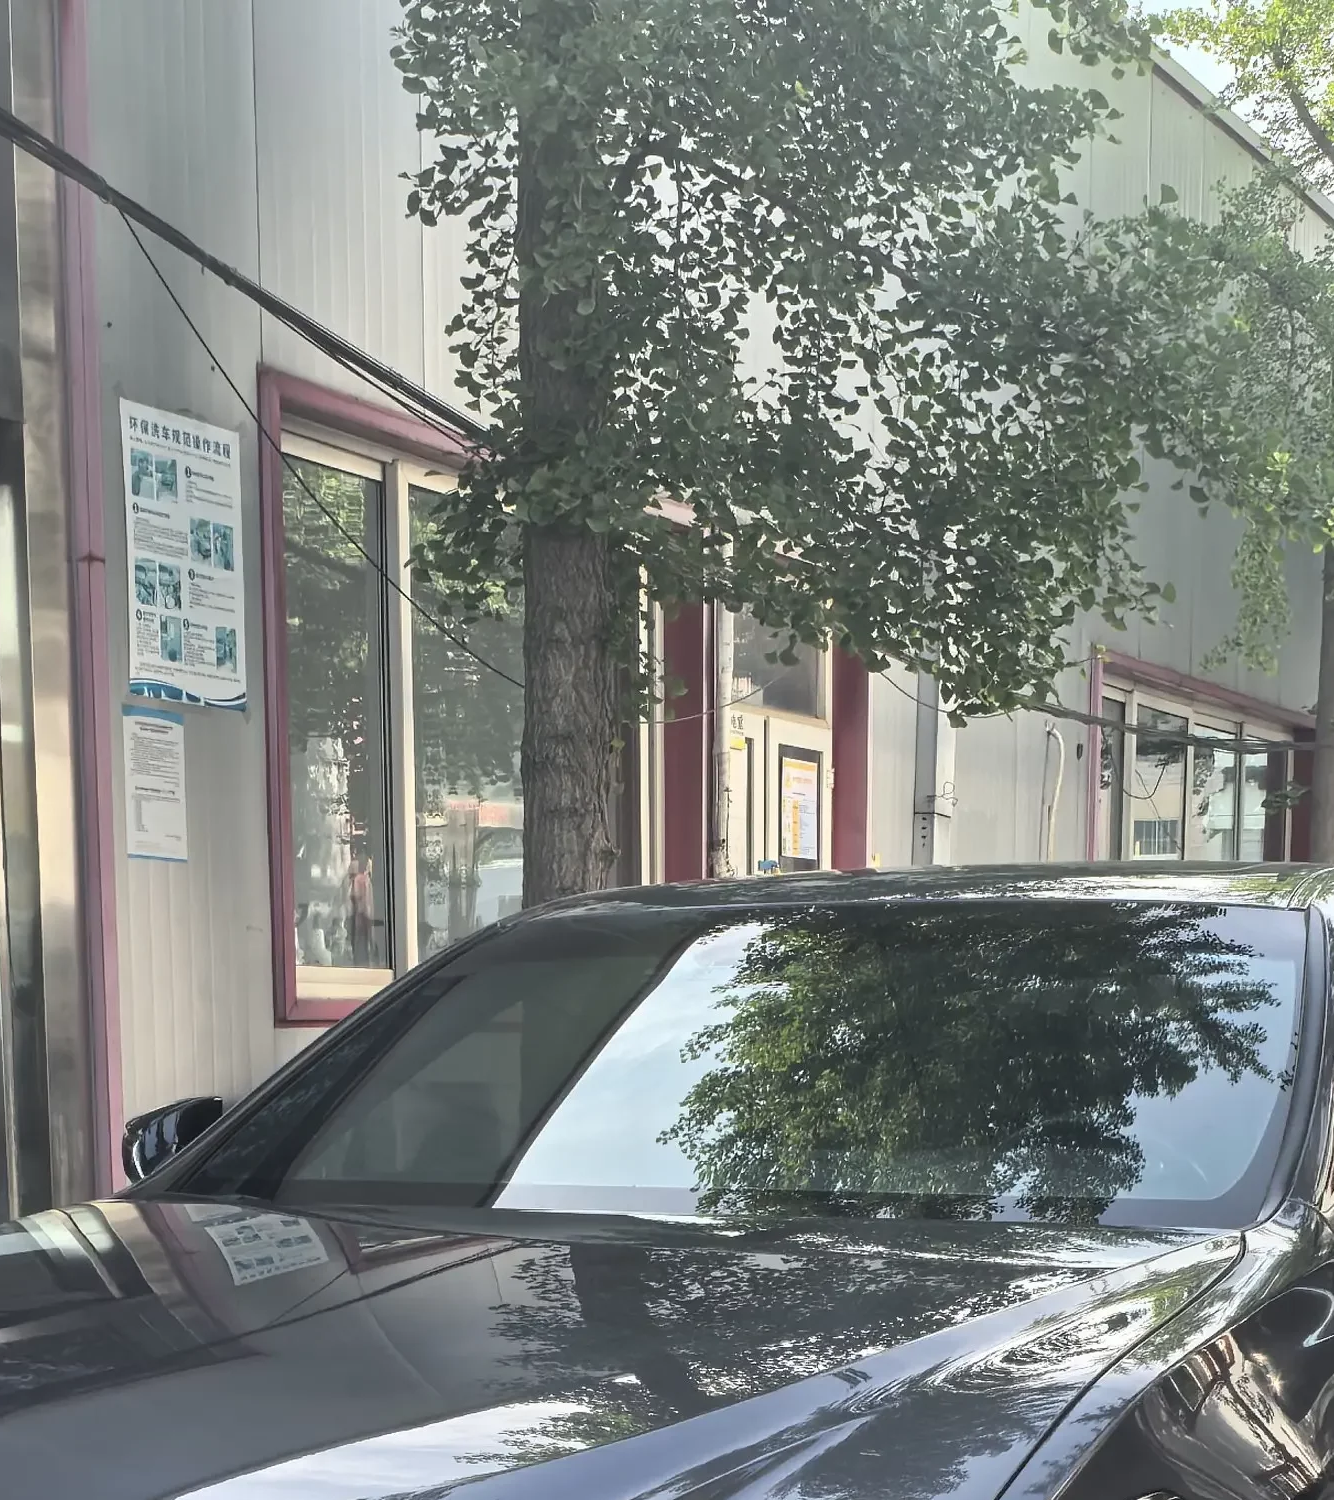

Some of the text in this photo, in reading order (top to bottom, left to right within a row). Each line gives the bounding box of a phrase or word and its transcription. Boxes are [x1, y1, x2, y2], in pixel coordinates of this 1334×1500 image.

[129, 415, 231, 460] 环保洗车规范操作流程
